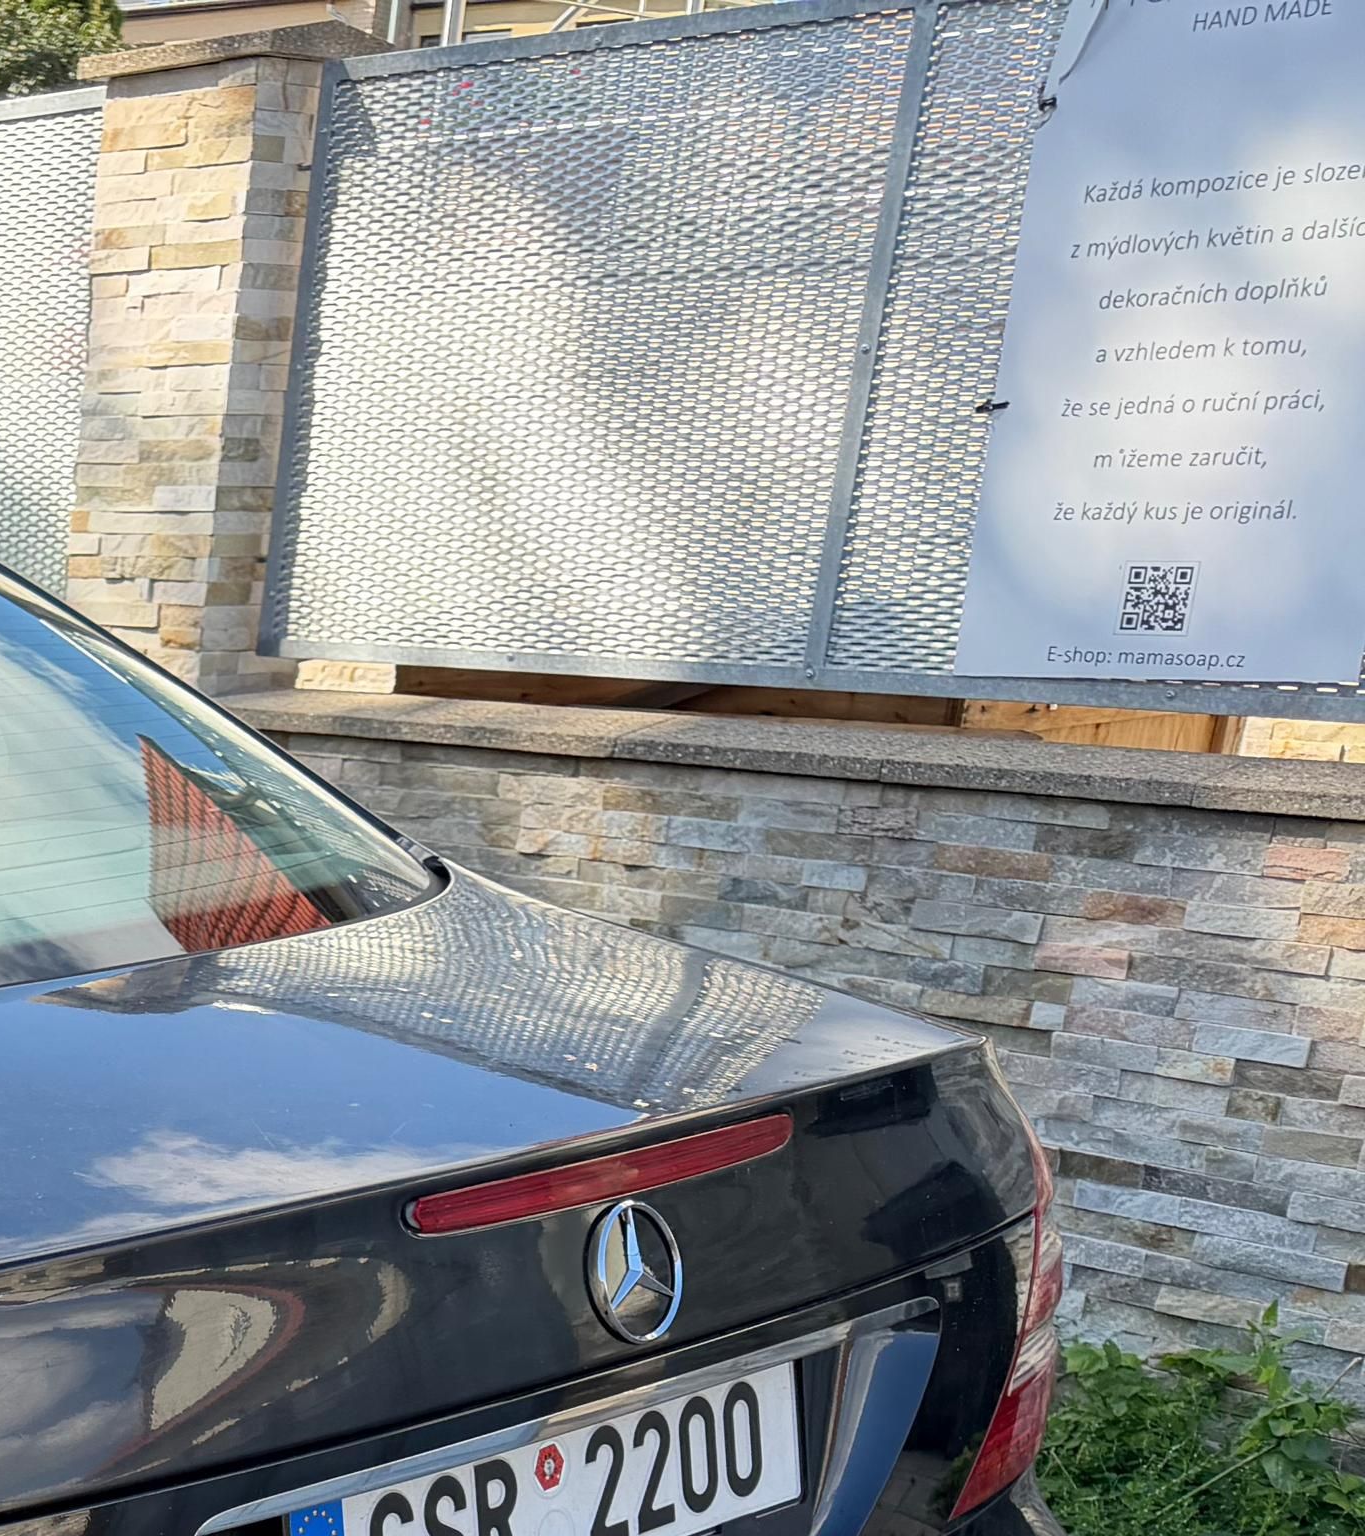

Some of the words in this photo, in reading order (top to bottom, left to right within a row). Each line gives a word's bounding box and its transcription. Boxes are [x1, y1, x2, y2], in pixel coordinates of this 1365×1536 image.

[1193, 6, 1258, 32] HAND
[1264, 0, 1334, 23] MADE
[1084, 178, 1144, 204] Každá
[1150, 170, 1269, 199] kompozice
[1272, 165, 1296, 191] je
[1303, 162, 1365, 184] sloze
[1070, 243, 1081, 259] z
[1086, 229, 1199, 261] mýdlových
[1206, 226, 1274, 249] květin
[1281, 226, 1294, 242] a
[1099, 282, 1227, 310] dekoračních
[1235, 275, 1329, 305] doplňků
[1095, 348, 1107, 363] a
[1114, 340, 1216, 362] vzhledem
[1223, 337, 1236, 358] k
[1242, 338, 1308, 358] tomu,
[1061, 398, 1083, 418] že
[1089, 401, 1111, 416] se
[1114, 394, 1175, 420] jedná
[1181, 397, 1195, 413] o
[1202, 391, 1261, 413] ruční
[1263, 389, 1326, 415] práci,
[1189, 446, 1268, 470] zaručit,
[1053, 501, 1075, 521] že
[1081, 501, 1138, 525] každý
[1143, 501, 1178, 521] kus
[1181, 501, 1203, 525] je
[1209, 499, 1298, 525] originál.
[1047, 646, 1113, 667] E-shop:
[1118, 649, 1246, 671] mamasoap.cz
